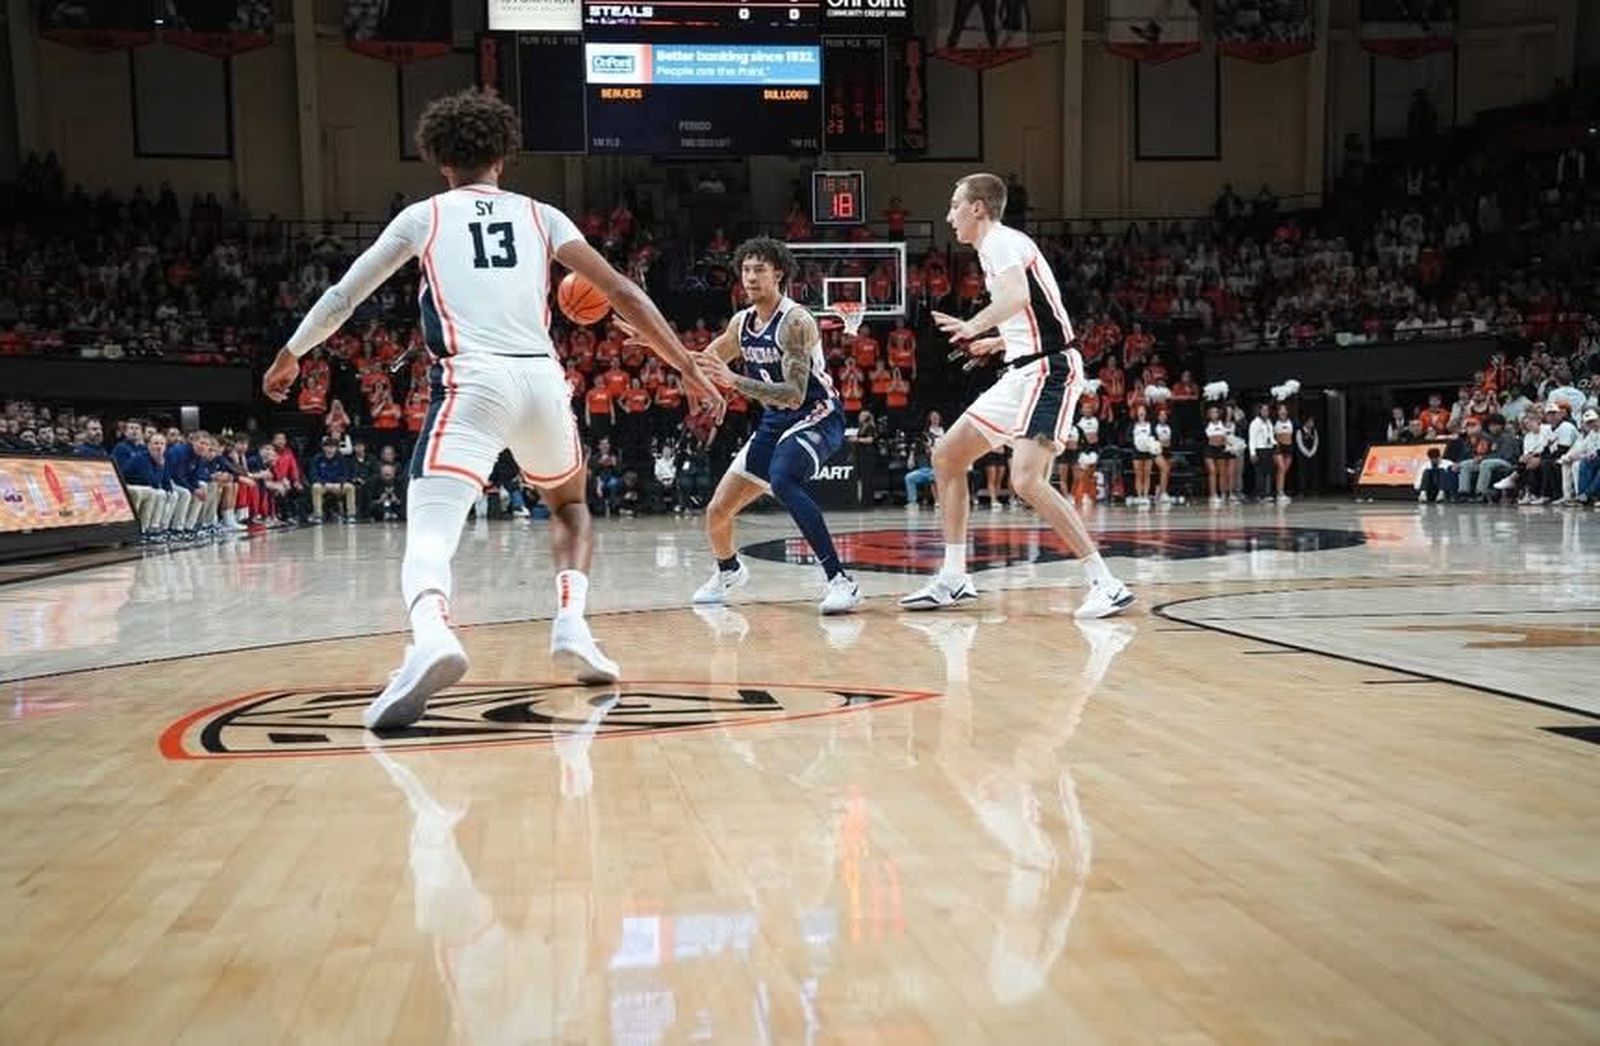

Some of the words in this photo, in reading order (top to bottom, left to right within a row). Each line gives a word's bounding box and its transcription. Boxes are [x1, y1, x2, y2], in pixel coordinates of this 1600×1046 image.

[589, 6, 653, 17] STEALS
[738, 8, 750, 19] 0
[789, 9, 800, 20] 0
[656, 50, 695, 62] Better
[696, 50, 748, 65] banking
[751, 51, 784, 63] since
[656, 66, 694, 77] People
[696, 67, 715, 76] are
[717, 66, 735, 76] the
[601, 88, 642, 99] BEAVERS
[763, 90, 808, 100] BULLDOGS
[475, 200, 493, 216] SY
[833, 193, 853, 217] 18
[468, 222, 518, 268] 13
[811, 466, 854, 480] ART
